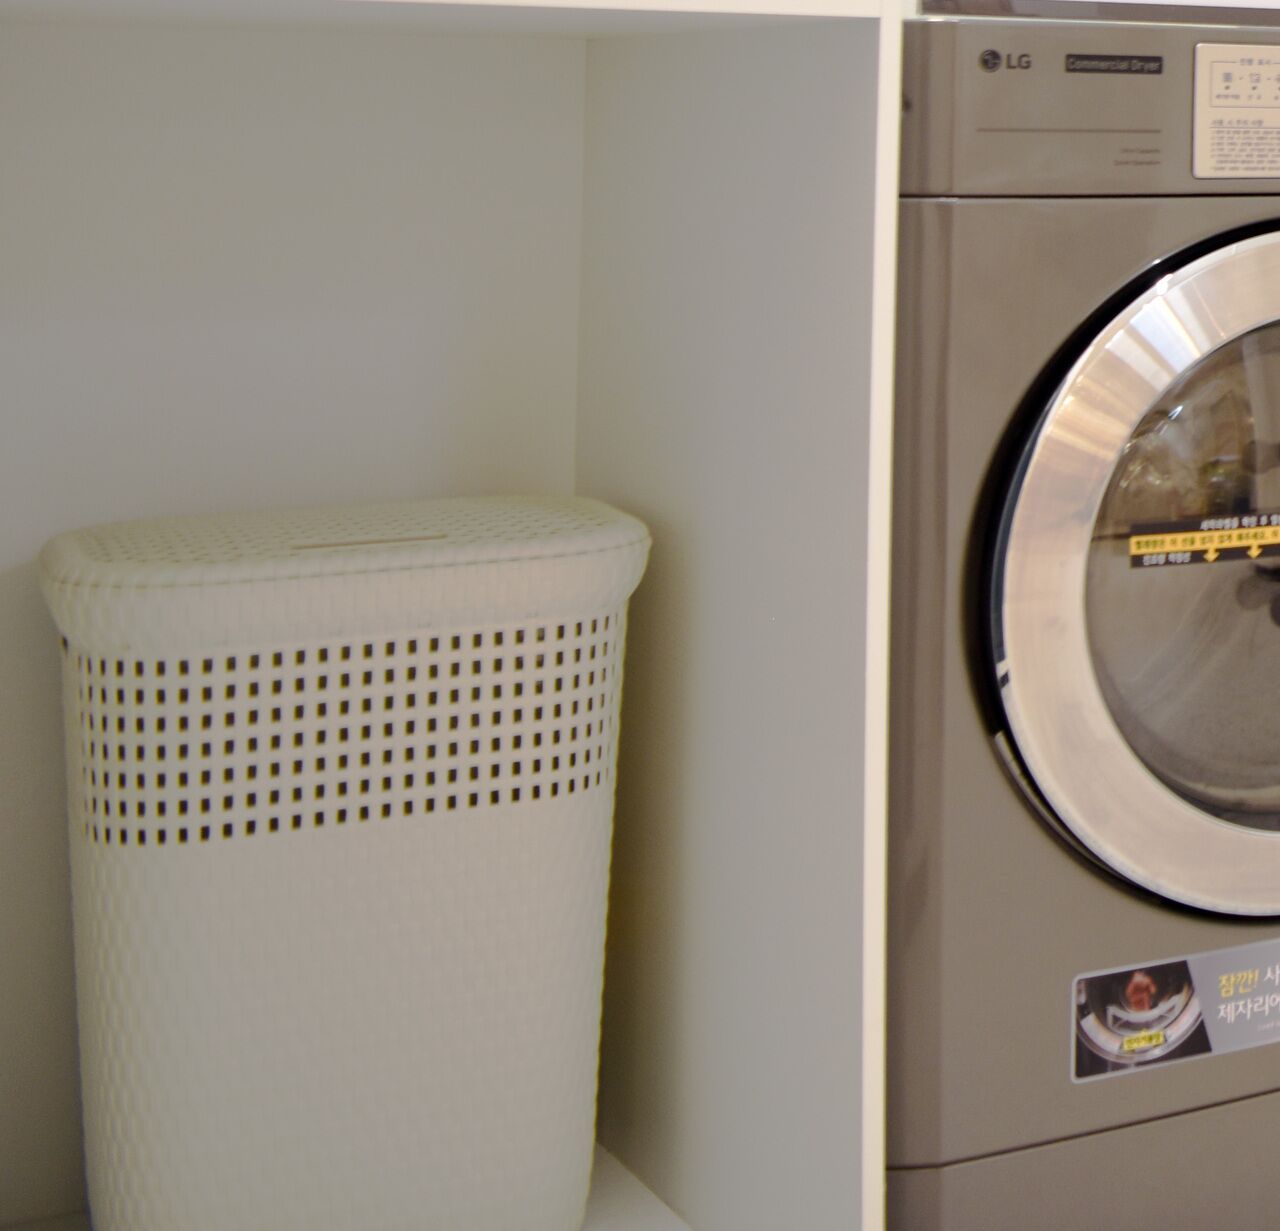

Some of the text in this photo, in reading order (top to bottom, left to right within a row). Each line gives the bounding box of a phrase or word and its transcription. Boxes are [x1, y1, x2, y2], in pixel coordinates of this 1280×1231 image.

[1006, 54, 1032, 69] LG
[1069, 58, 1160, 73] Commercial Dryer
[1219, 968, 1260, 998] 잠깐!
